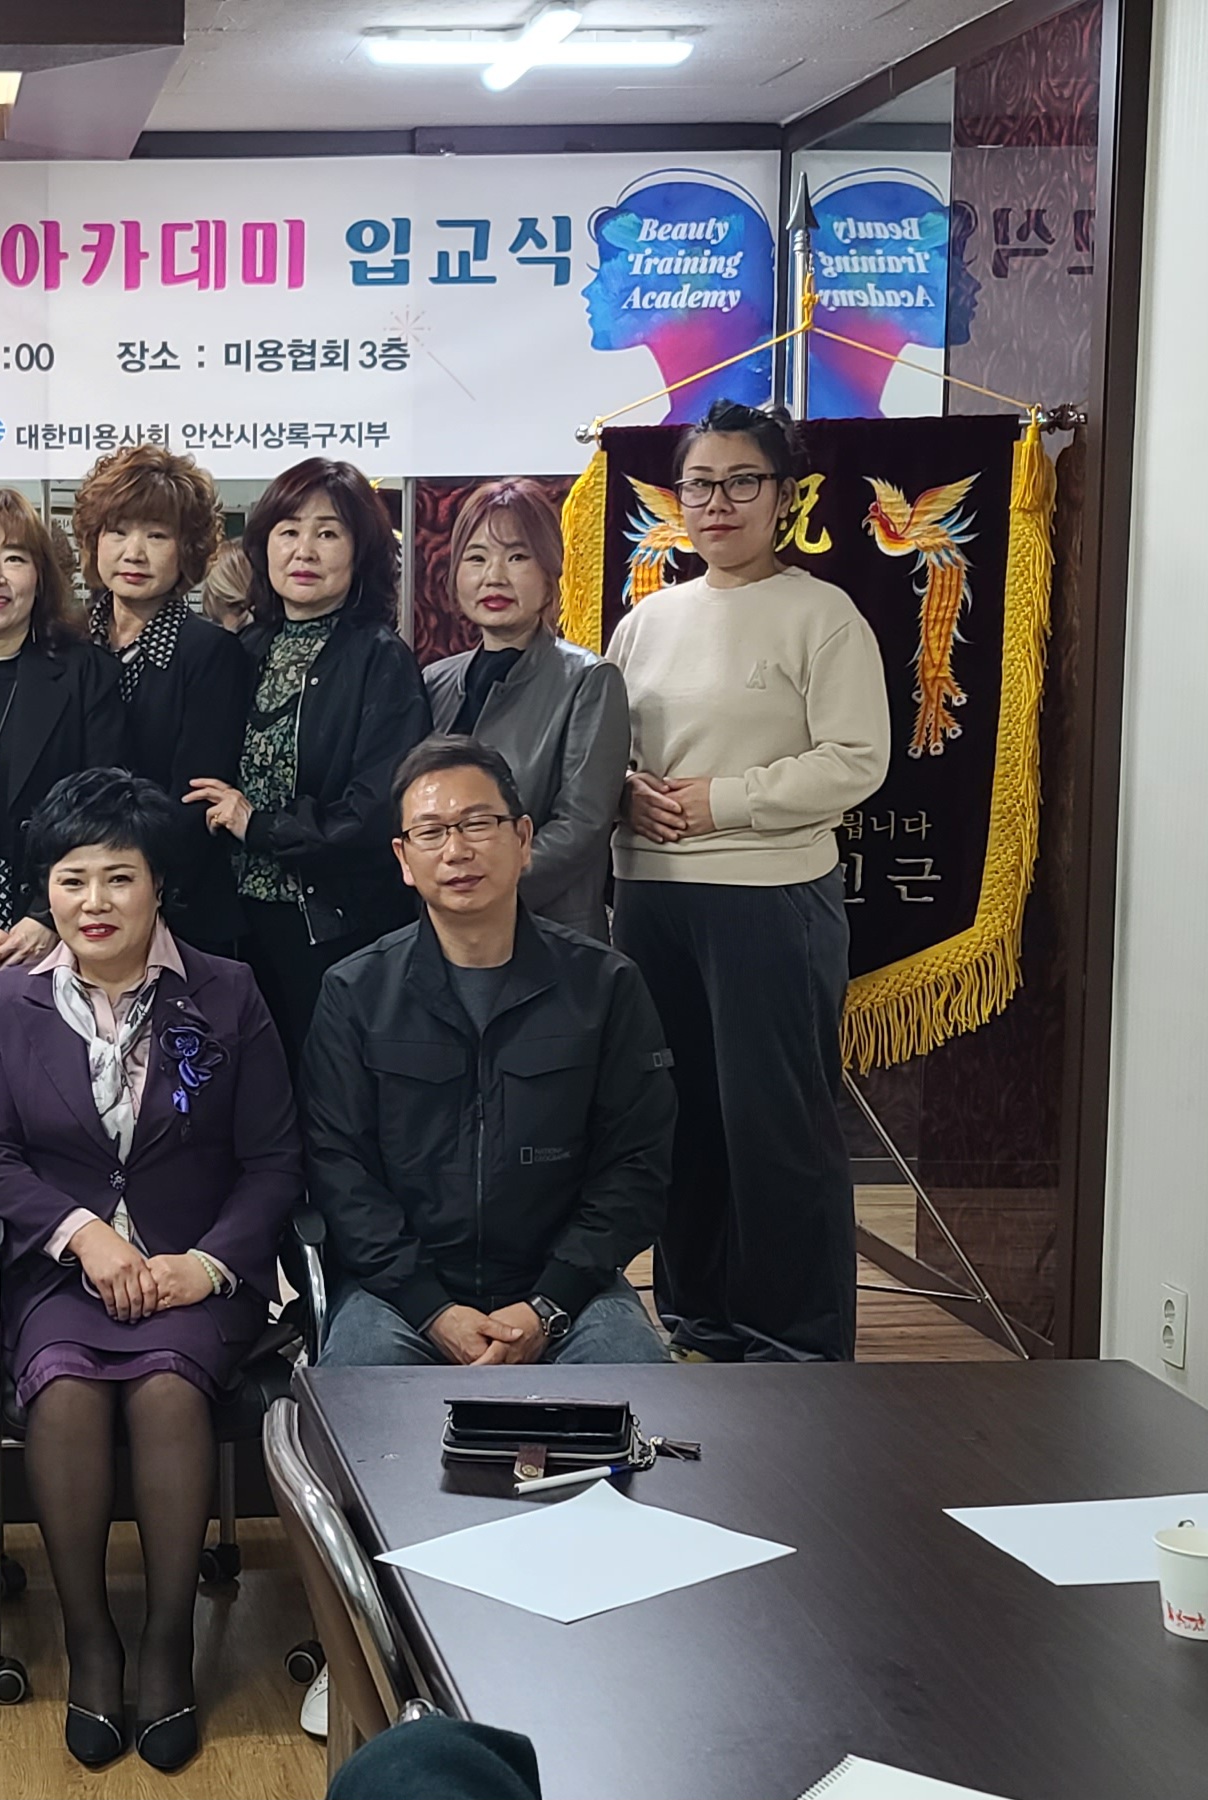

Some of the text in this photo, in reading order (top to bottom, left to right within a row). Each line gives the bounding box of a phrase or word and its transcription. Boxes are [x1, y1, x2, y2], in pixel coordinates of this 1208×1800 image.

[637, 217, 730, 245] Beauty
[345, 215, 572, 287] 입교식
[627, 247, 744, 279] Training
[621, 283, 742, 313] Academy
[117, 340, 181, 373] 장소
[16, 421, 390, 450] 대한미용사회 안산시상록구지부
